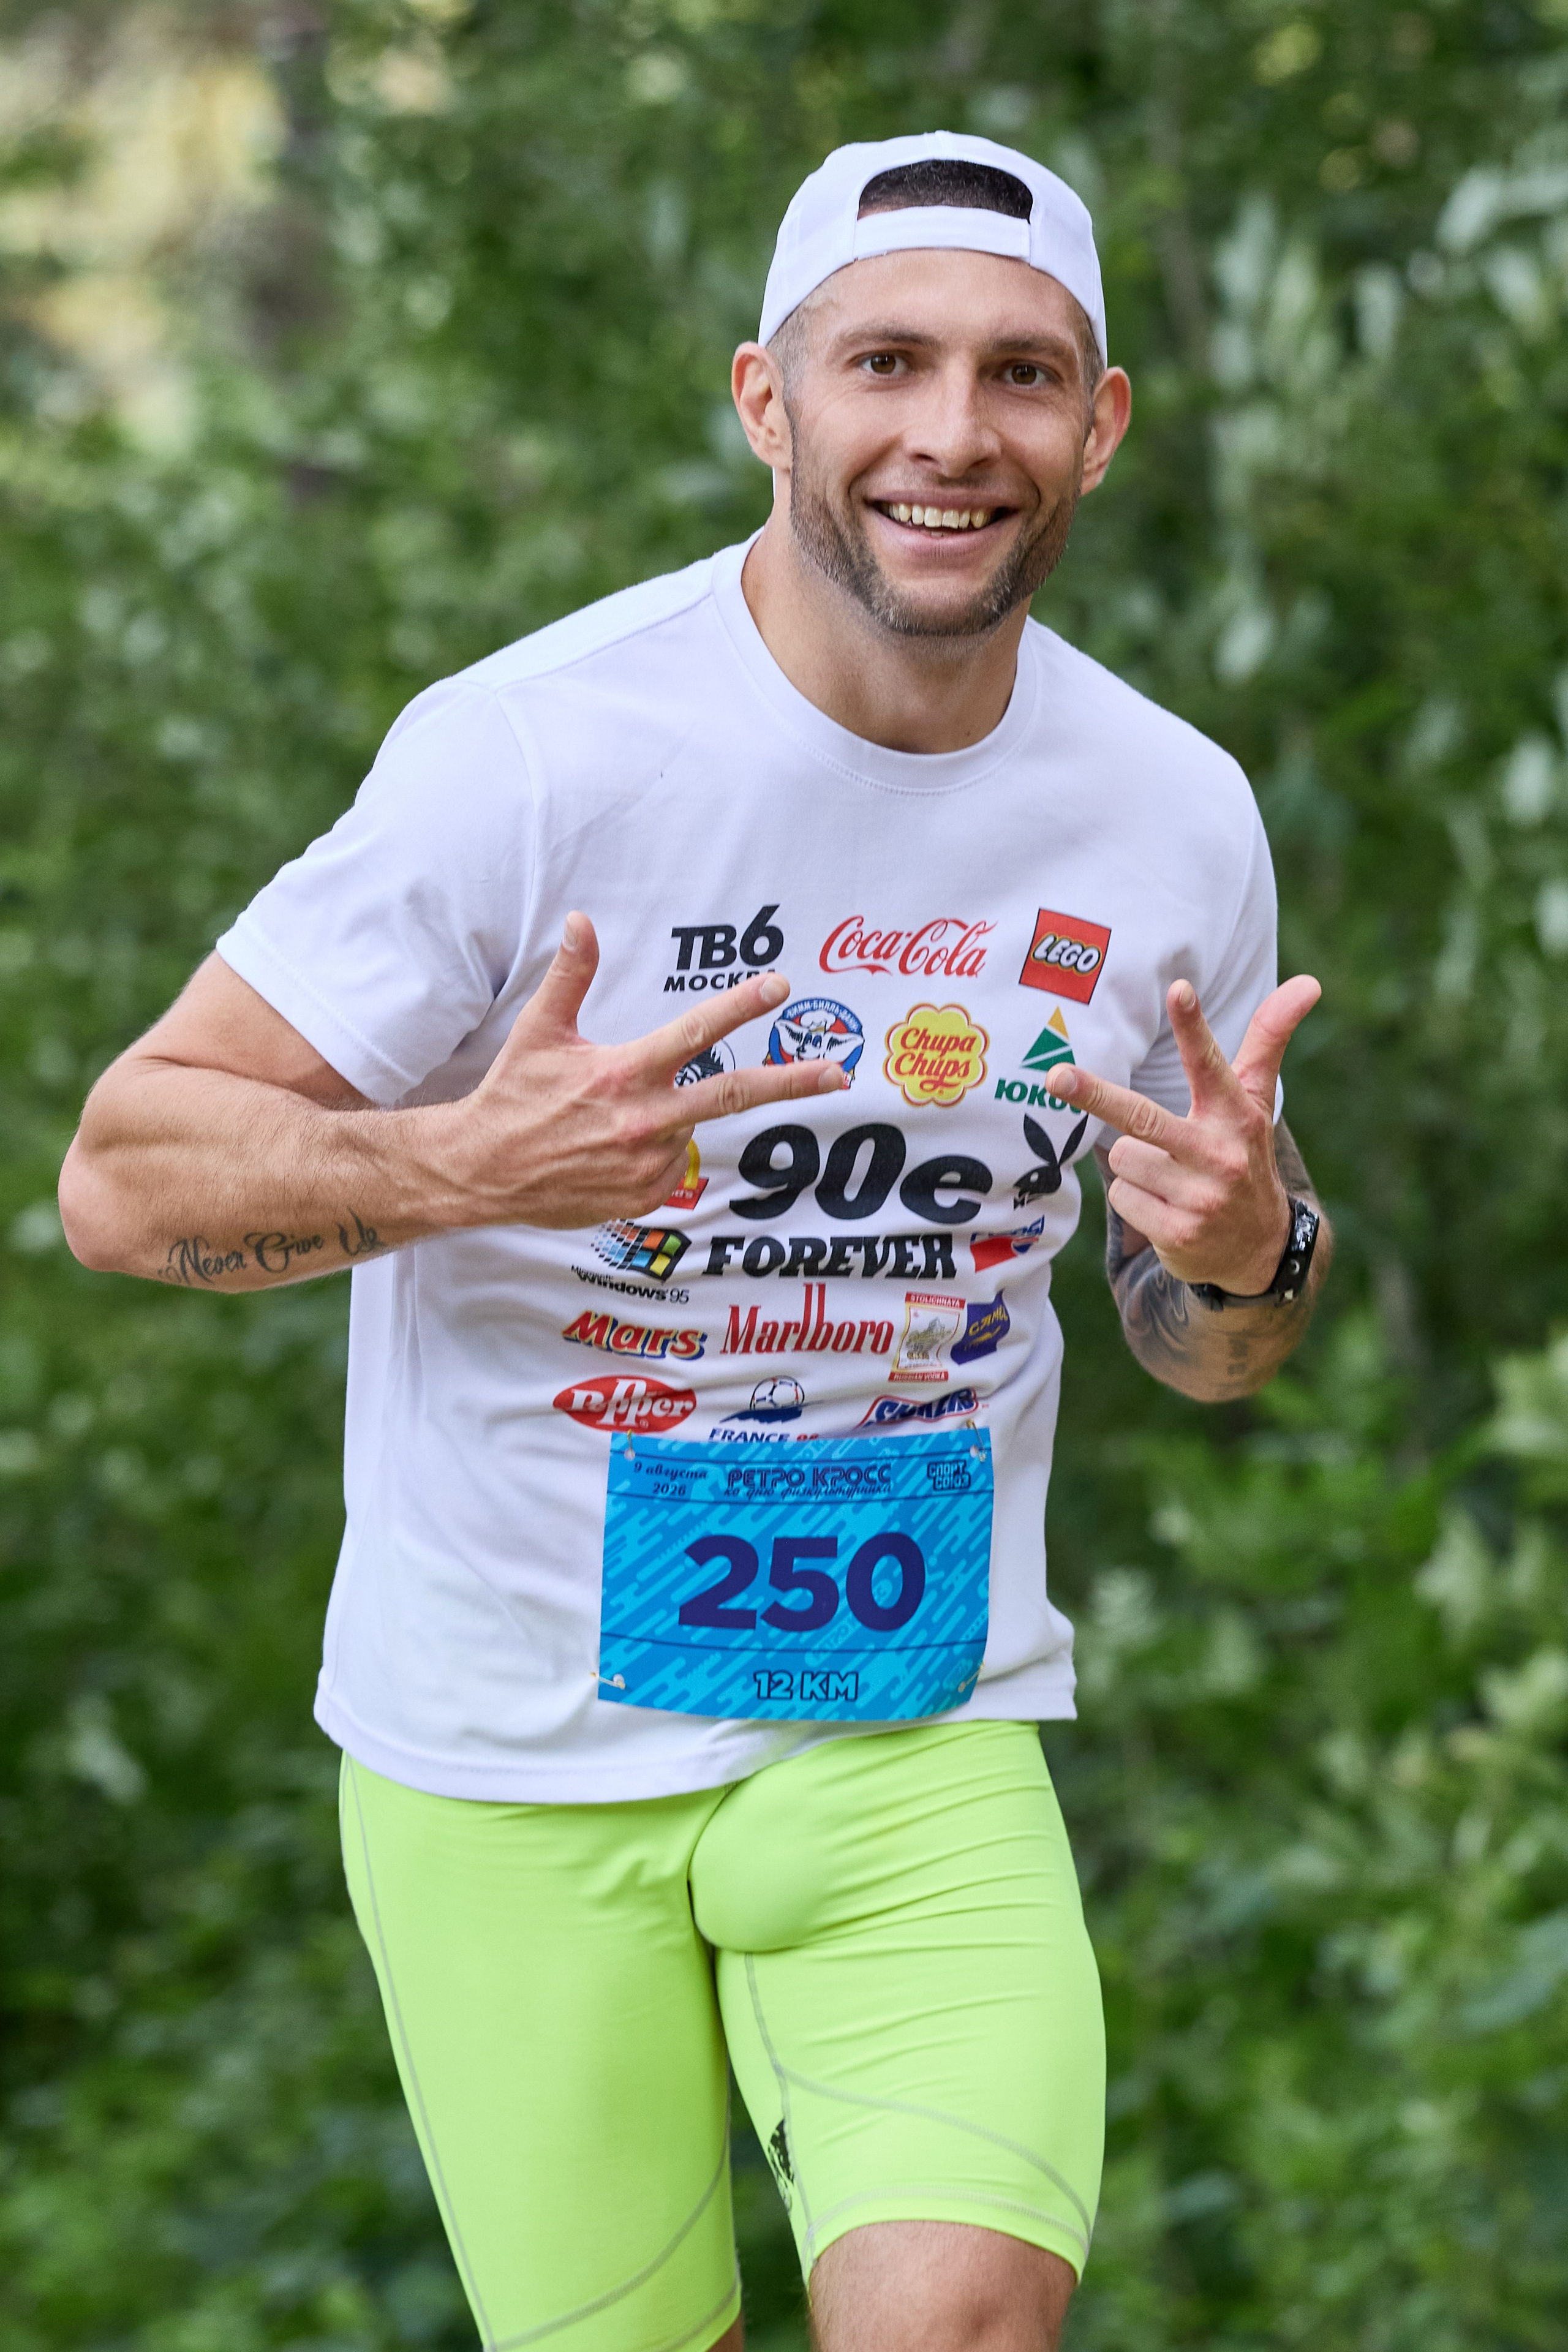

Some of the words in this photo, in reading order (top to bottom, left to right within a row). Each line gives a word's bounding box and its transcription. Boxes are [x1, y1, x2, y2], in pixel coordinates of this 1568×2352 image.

[819, 915, 998, 978] Coca-Cola
[1033, 933, 1101, 974] LEGO
[663, 969, 774, 993] МОСК
[900, 1027, 976, 1057] Chupa
[894, 1052, 970, 1092] Chups
[245, 1231, 325, 1274] Give
[702, 1234, 957, 1279] FOREVER
[669, 1287, 690, 1305] 95
[562, 1311, 706, 1360] Mars
[720, 1283, 894, 1355] Marlboro
[634, 1461, 643, 1473] 9
[728, 1467, 805, 1488] РЕТРО
[812, 1462, 892, 1488] КРОСС
[678, 1532, 926, 1632] 250
[754, 1670, 793, 1700] 12
